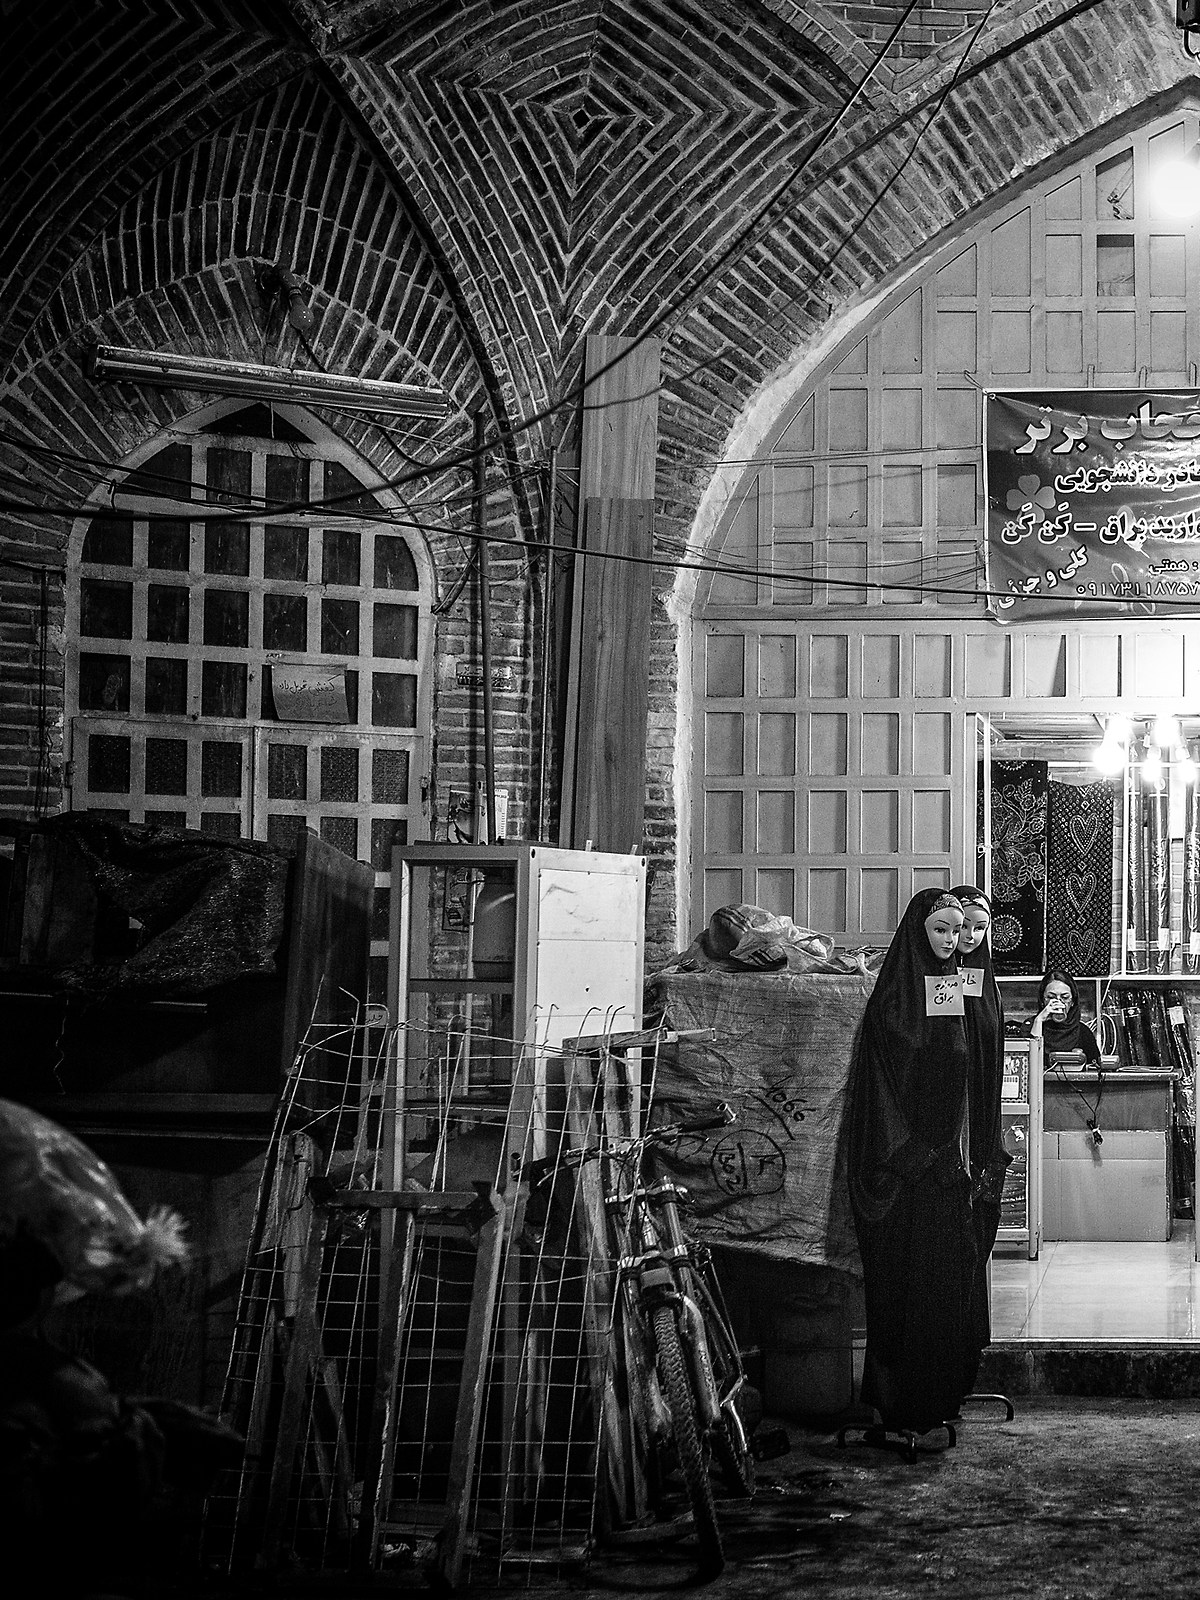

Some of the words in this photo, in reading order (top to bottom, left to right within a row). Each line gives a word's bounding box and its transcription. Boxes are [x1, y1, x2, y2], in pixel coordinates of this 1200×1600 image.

[1015, 406, 1089, 454] برتر
[1055, 459, 1160, 493] دانشجویی
[1099, 510, 1147, 543] براق
[1059, 544, 1088, 580] کلی
[1149, 557, 1190, 575] همتی
[1045, 569, 1058, 589] و
